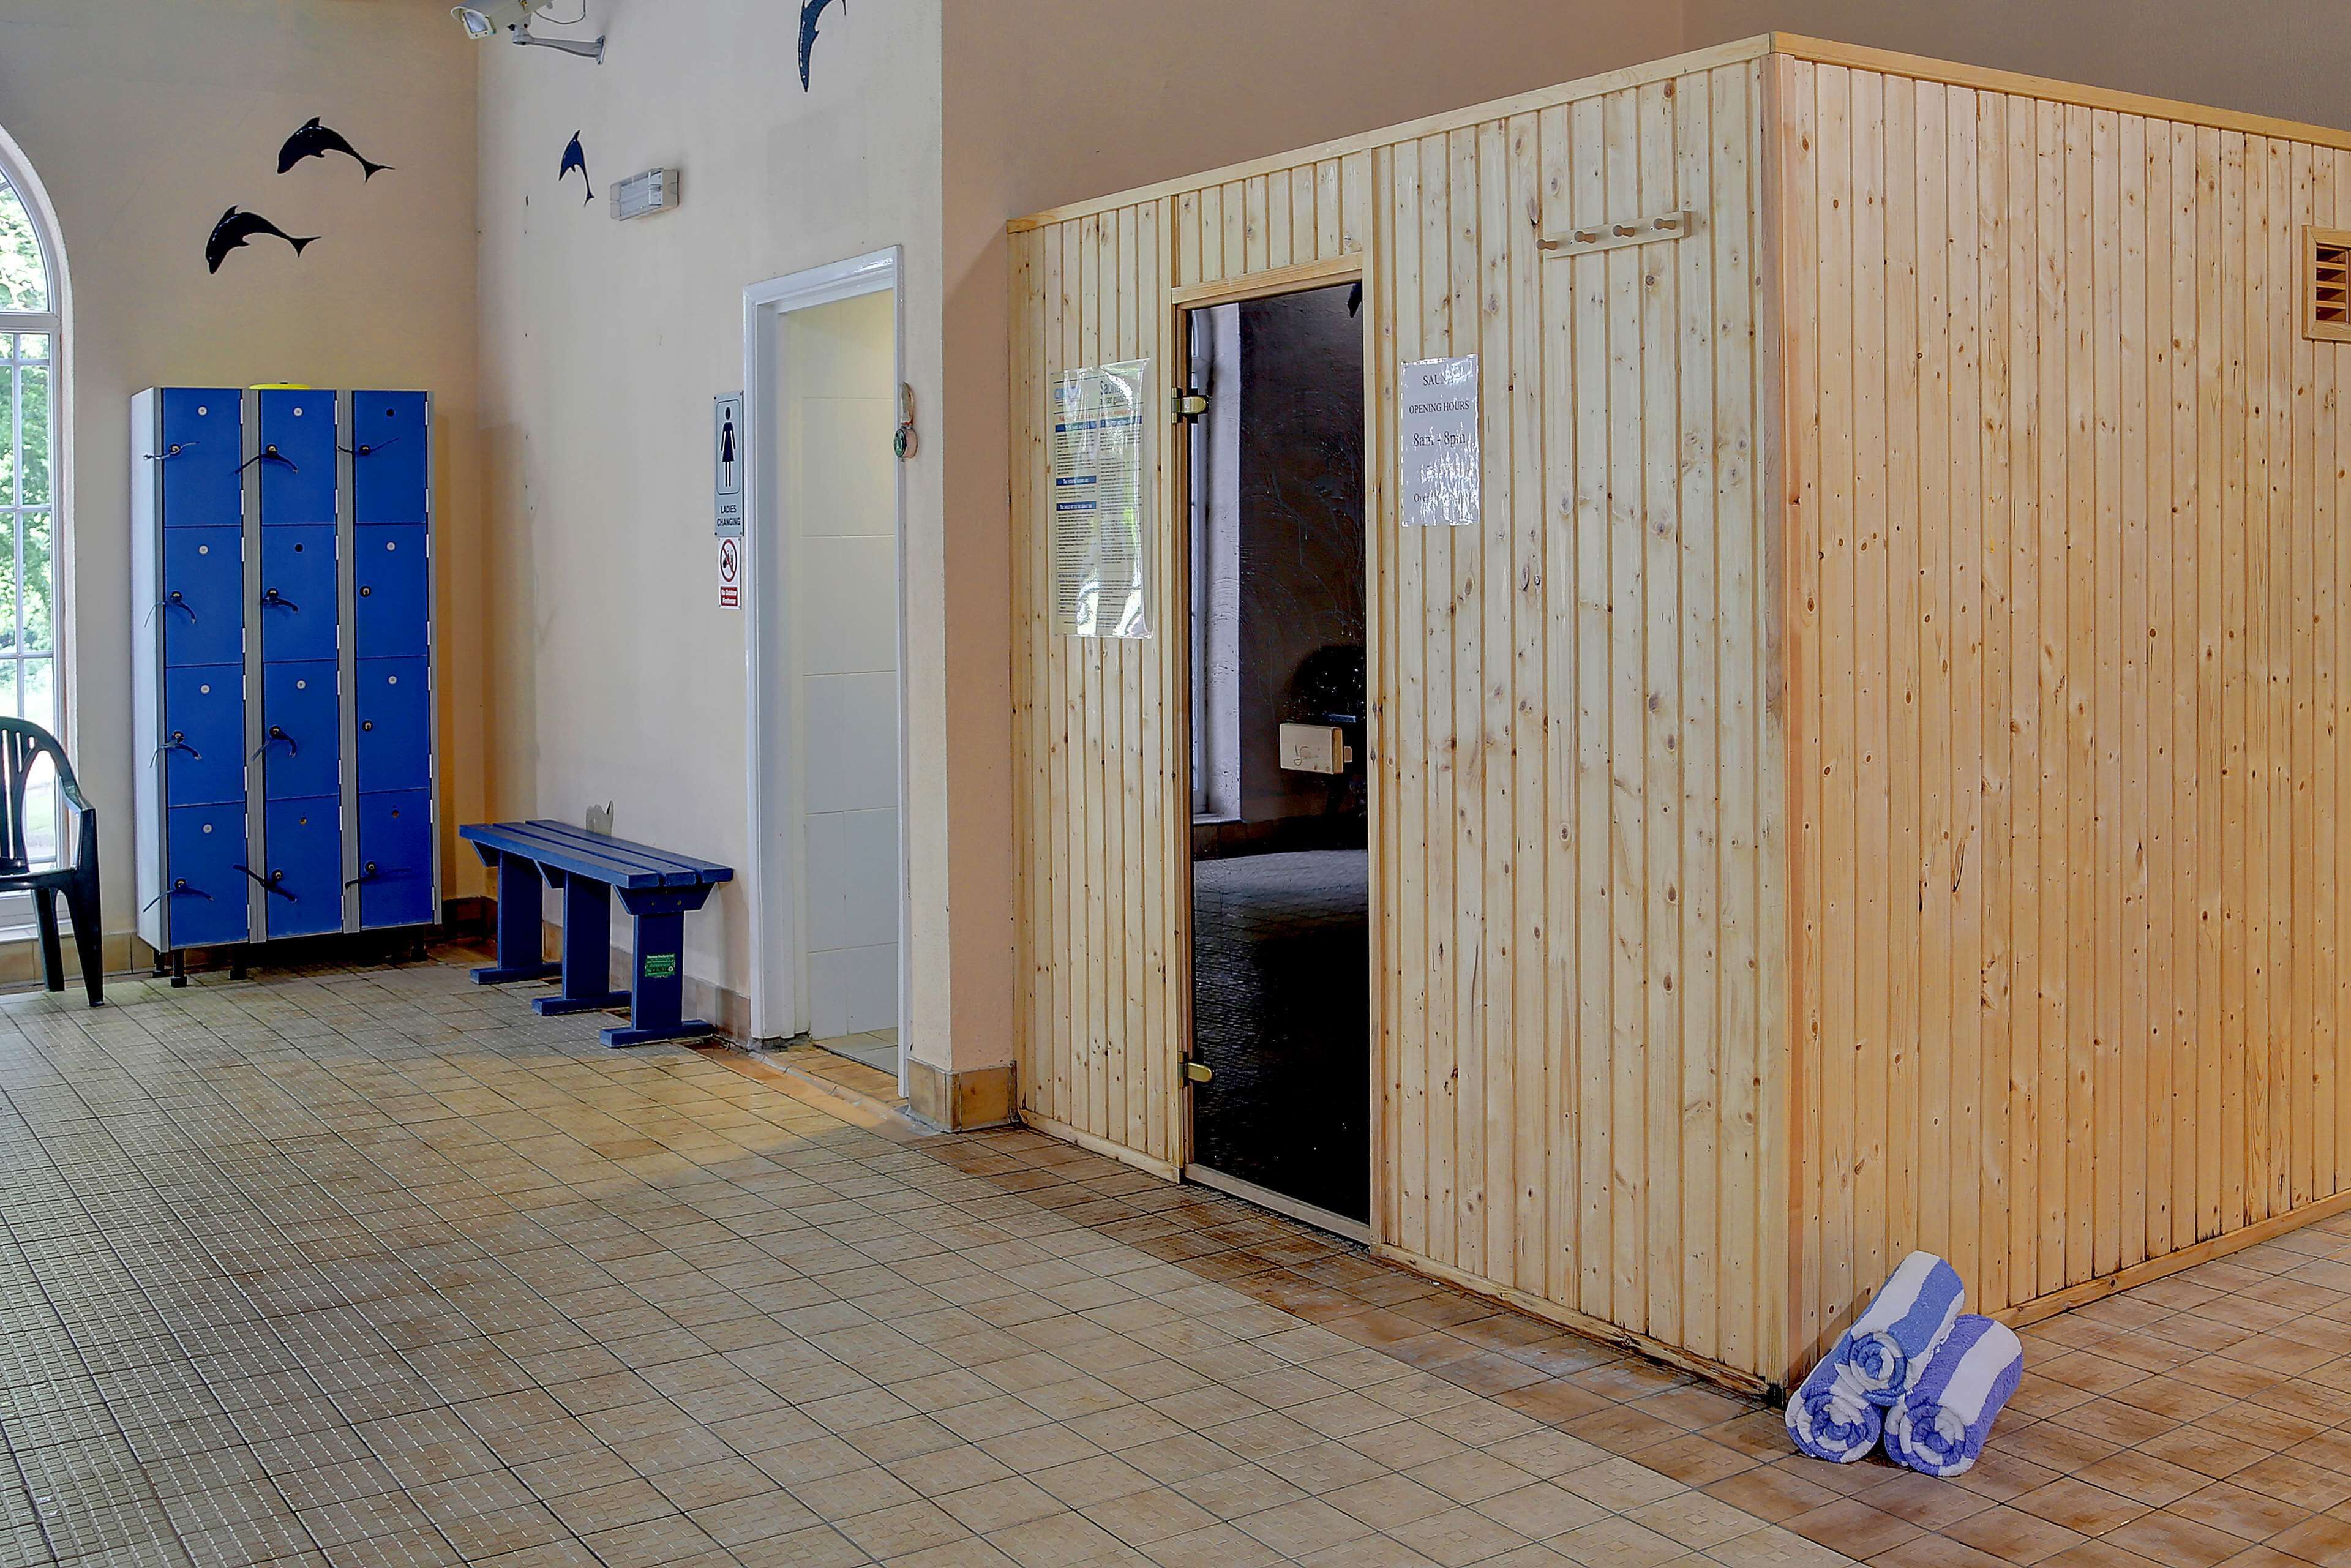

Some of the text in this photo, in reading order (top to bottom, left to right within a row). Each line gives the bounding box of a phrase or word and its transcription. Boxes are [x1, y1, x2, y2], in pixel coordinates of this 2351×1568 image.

[1423, 373, 1454, 386] SAUN
[1409, 400, 1469, 414] OPENING HOURS
[1444, 431, 1466, 448] 8pm
[721, 504, 737, 514] LADIES
[716, 517, 740, 527] CHANGING
